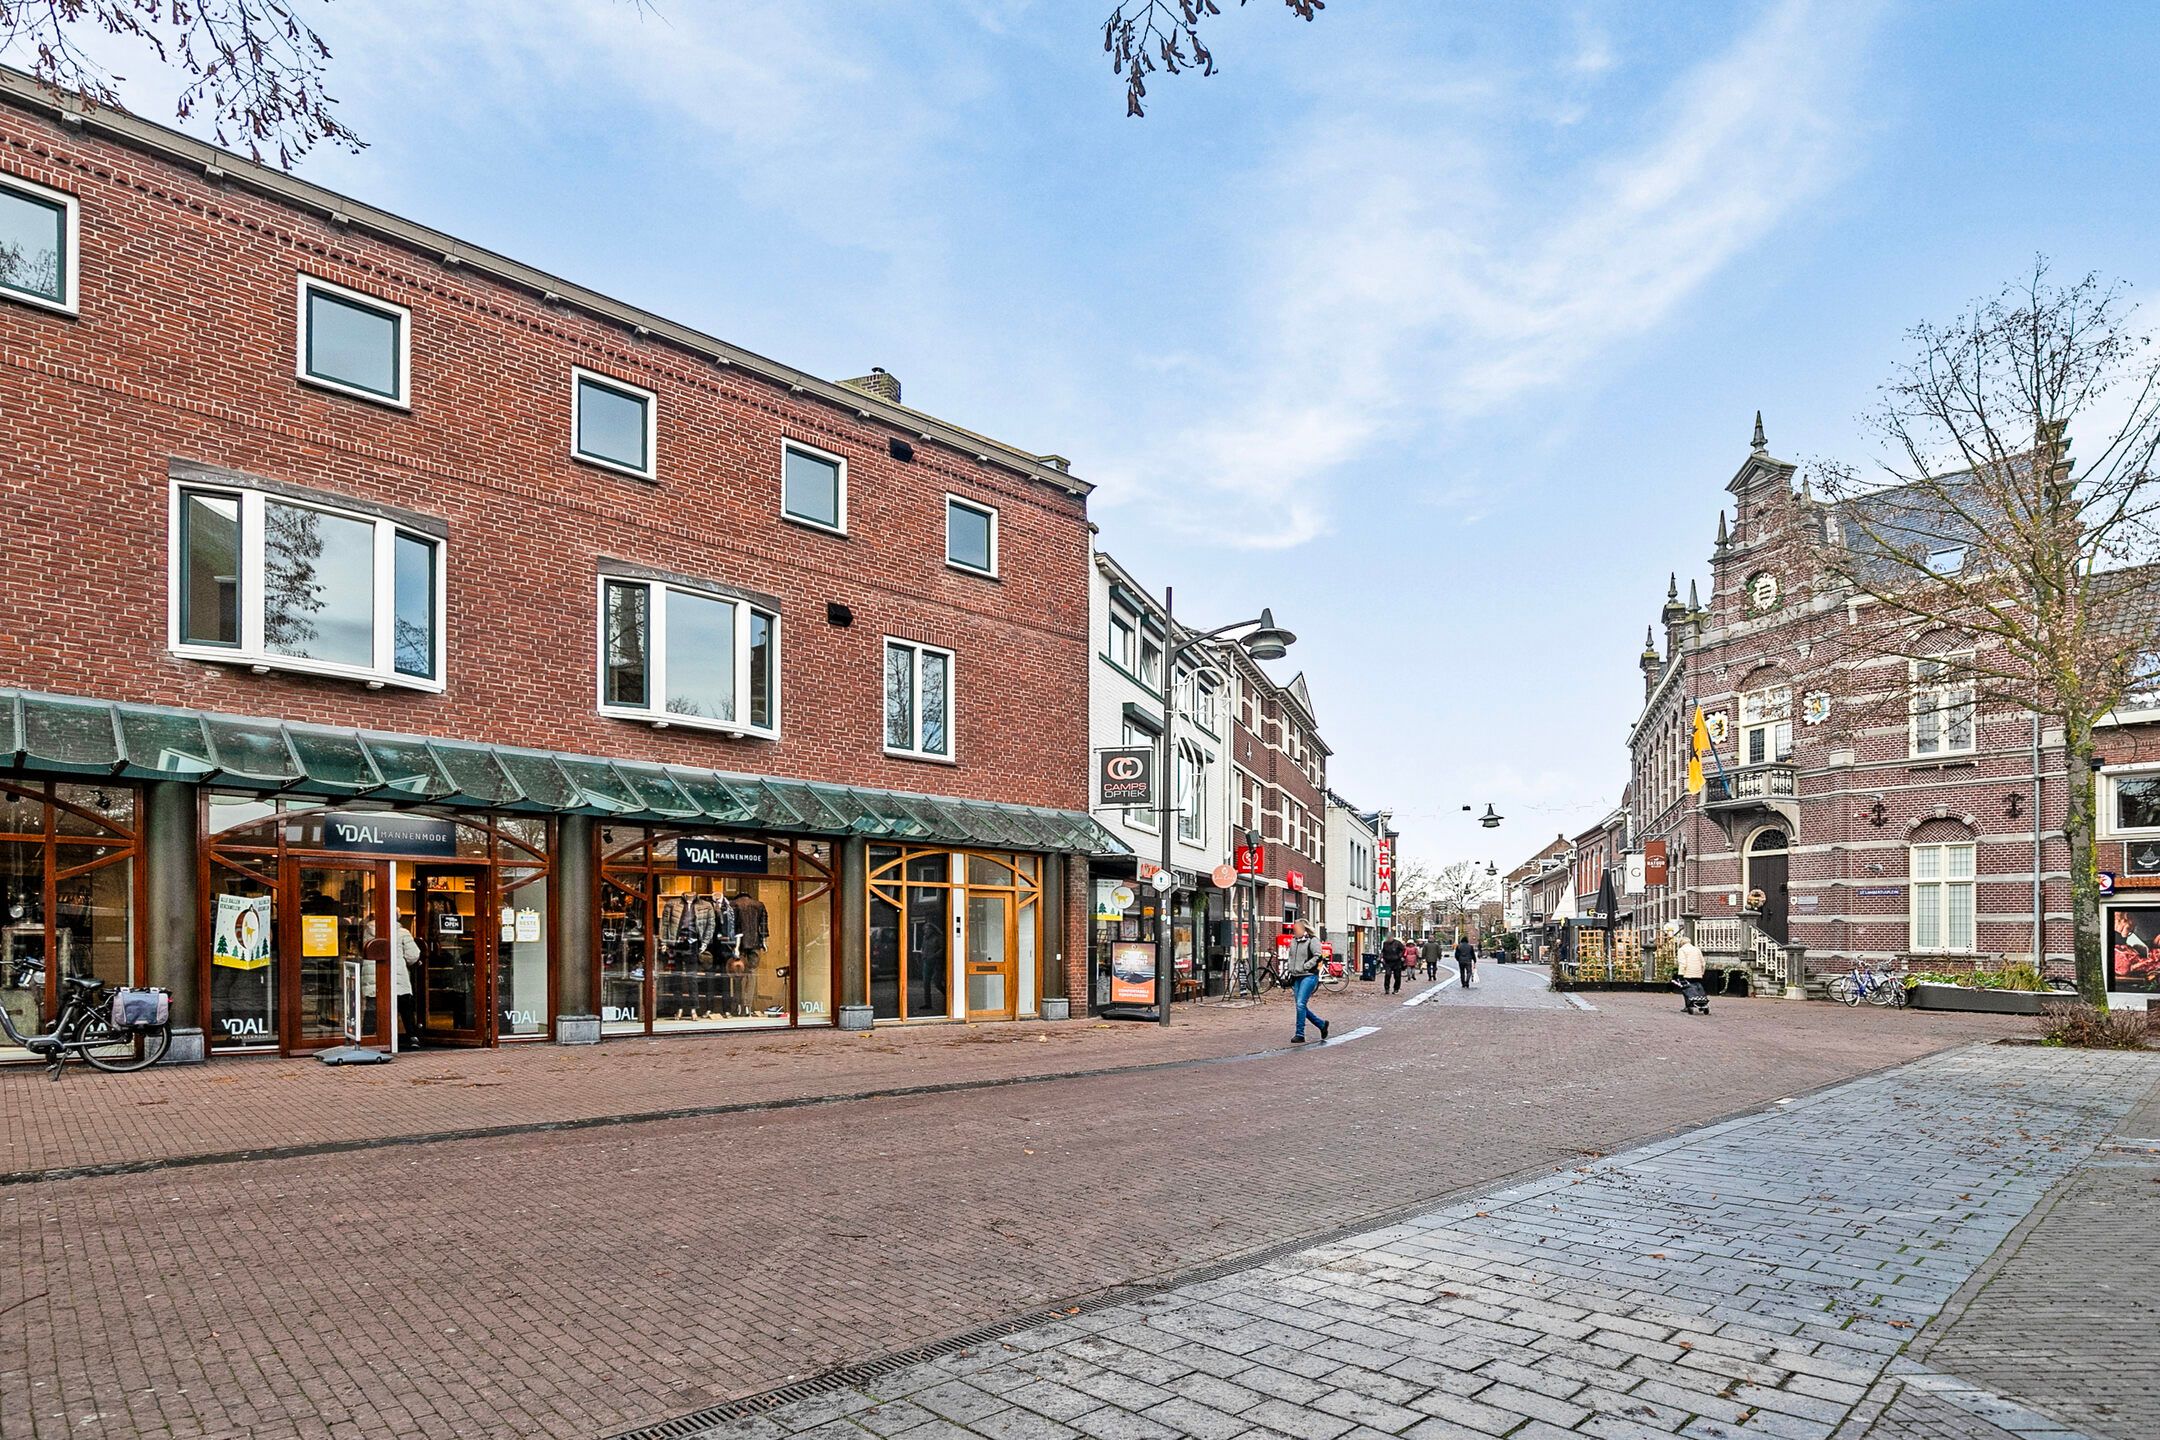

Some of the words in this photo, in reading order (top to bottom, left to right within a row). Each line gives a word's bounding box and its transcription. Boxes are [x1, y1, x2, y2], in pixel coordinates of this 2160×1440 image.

[1104, 783, 1147, 791] CAMPS
[1104, 790, 1146, 798] OPTIEK
[381, 831, 447, 842] MANNENMODE
[715, 853, 762, 862] MANNENMODE
[1379, 838, 1391, 893] HEMA
[614, 1007, 638, 1021] DAL
